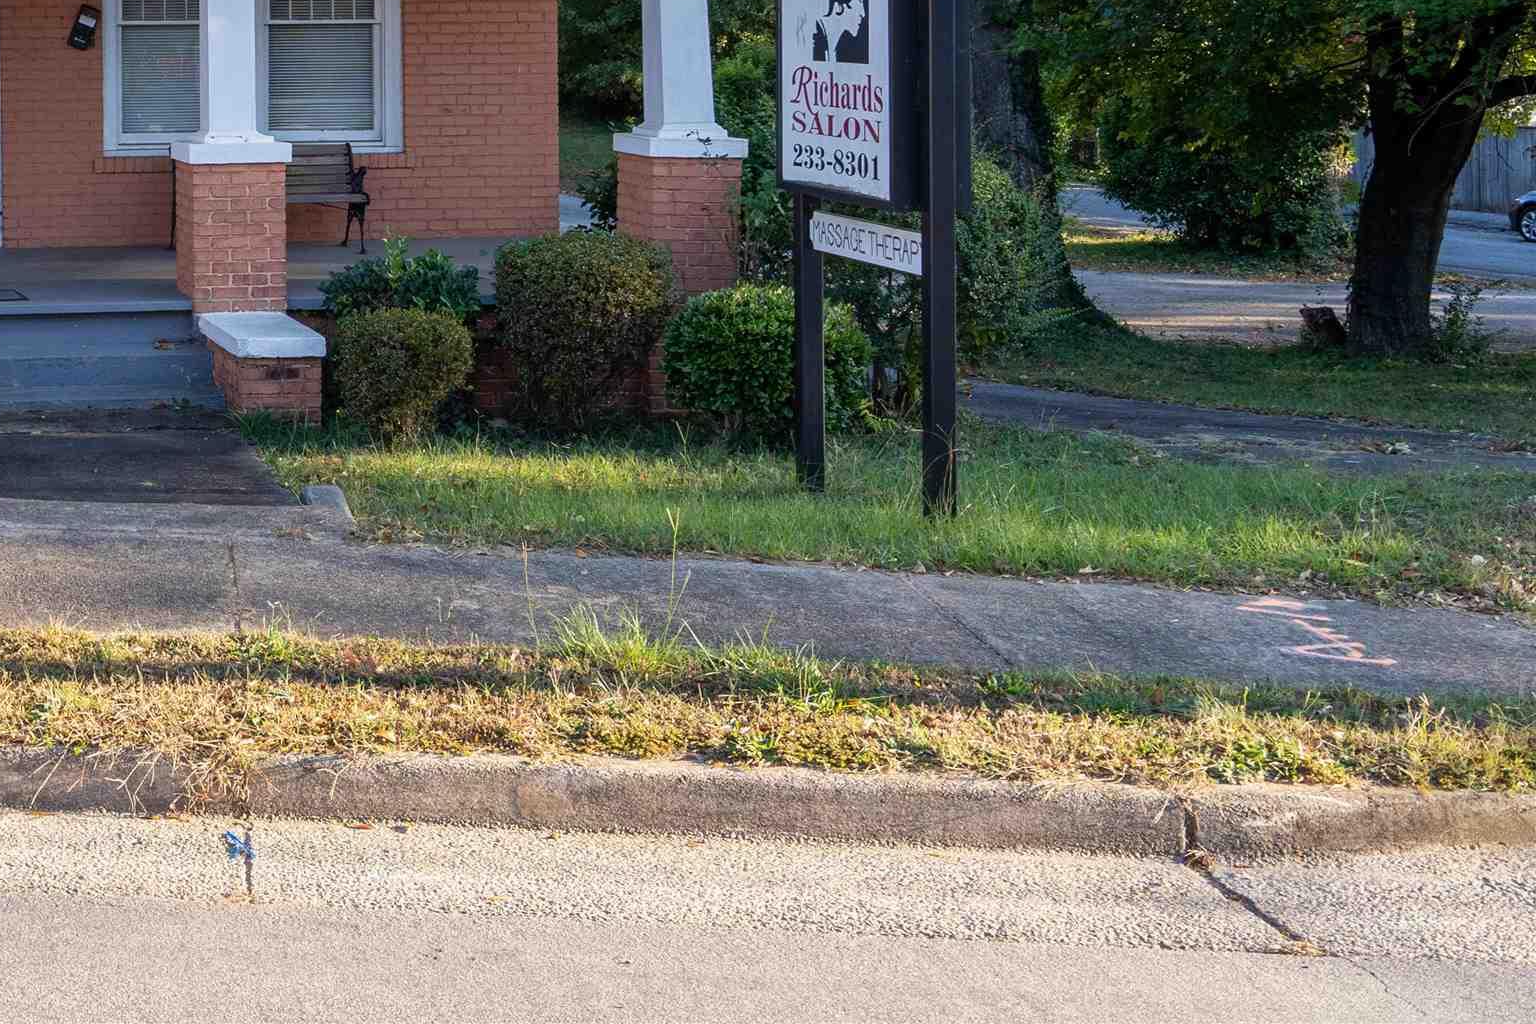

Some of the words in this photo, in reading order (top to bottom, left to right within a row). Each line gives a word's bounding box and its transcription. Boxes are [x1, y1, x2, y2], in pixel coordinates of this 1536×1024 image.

[790, 65, 884, 116] Richards
[791, 110, 882, 144] SALON
[793, 143, 881, 181] 233-8301
[812, 220, 866, 255] MASSAGE
[868, 230, 922, 265] THERAP
